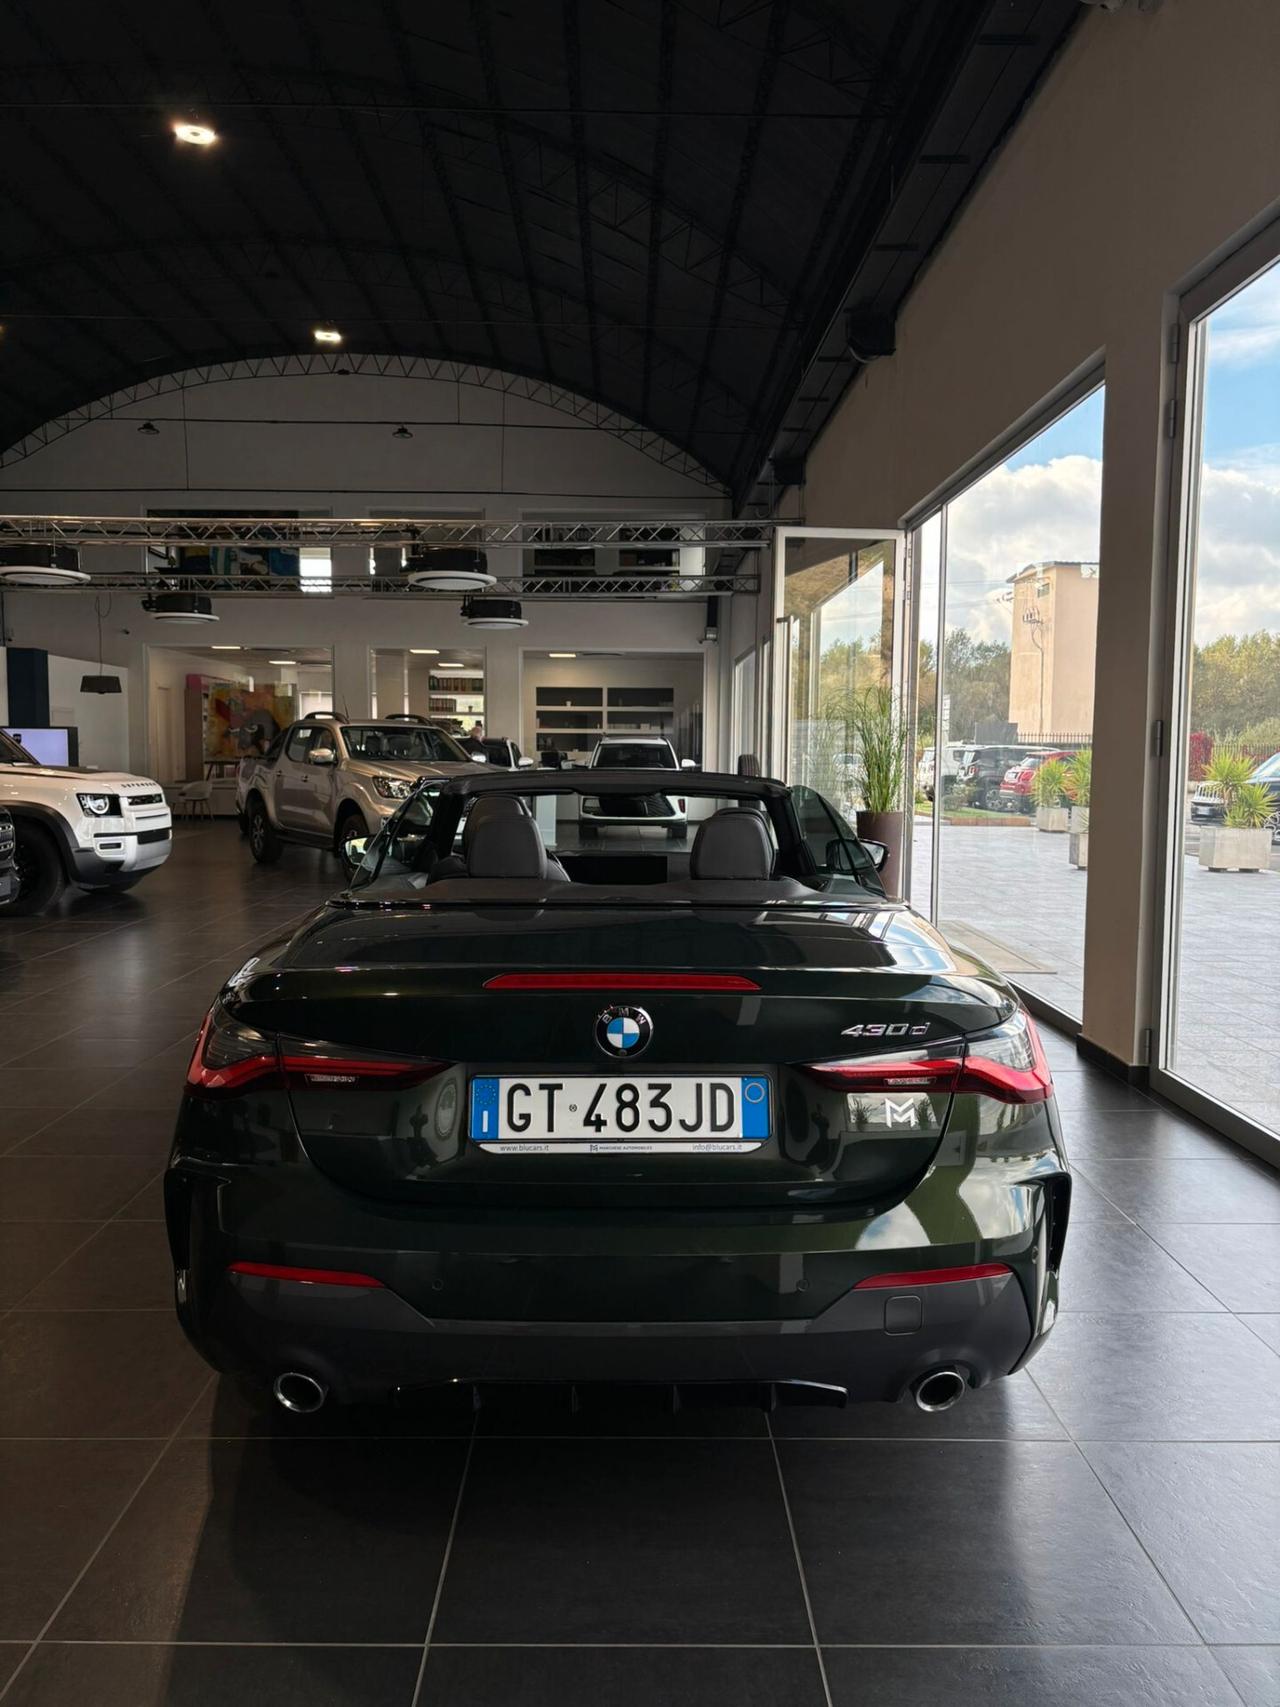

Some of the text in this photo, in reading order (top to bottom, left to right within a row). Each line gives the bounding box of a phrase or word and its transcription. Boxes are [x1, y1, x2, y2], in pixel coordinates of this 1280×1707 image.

[841, 1022, 930, 1037] 430d
[507, 1083, 735, 1133] GT 483JD
[500, 1144, 549, 1152] www.blucars.it
[692, 1144, 742, 1152] info@blucars.it
